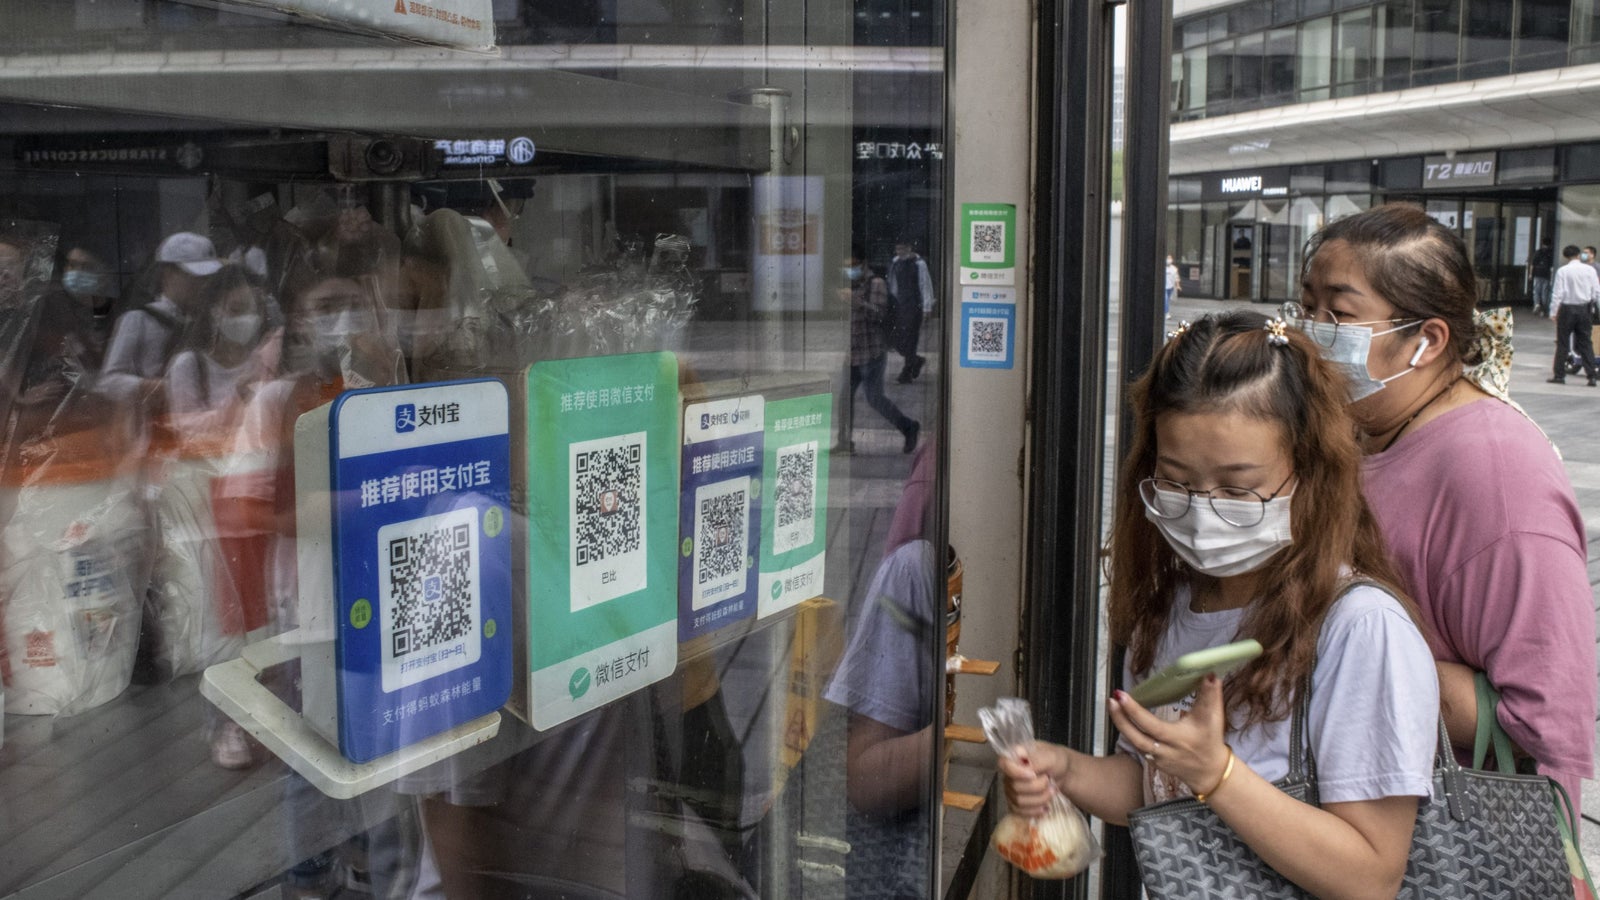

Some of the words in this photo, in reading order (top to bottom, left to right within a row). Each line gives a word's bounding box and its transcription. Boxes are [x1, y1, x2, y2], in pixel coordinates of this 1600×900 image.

[1221, 175, 1262, 193] HUAWEI
[1427, 163, 1452, 180] T2
[560, 383, 655, 413] 推荐使用微信支付
[417, 402, 460, 427] 支付宝
[692, 446, 755, 475] 推荐使用支付宝
[360, 460, 491, 508] 推荐使用支付宝
[601, 569, 617, 584] 巴比
[595, 646, 650, 688] 微信支付
[382, 676, 482, 726] 支付得蚂蚁森林能量
